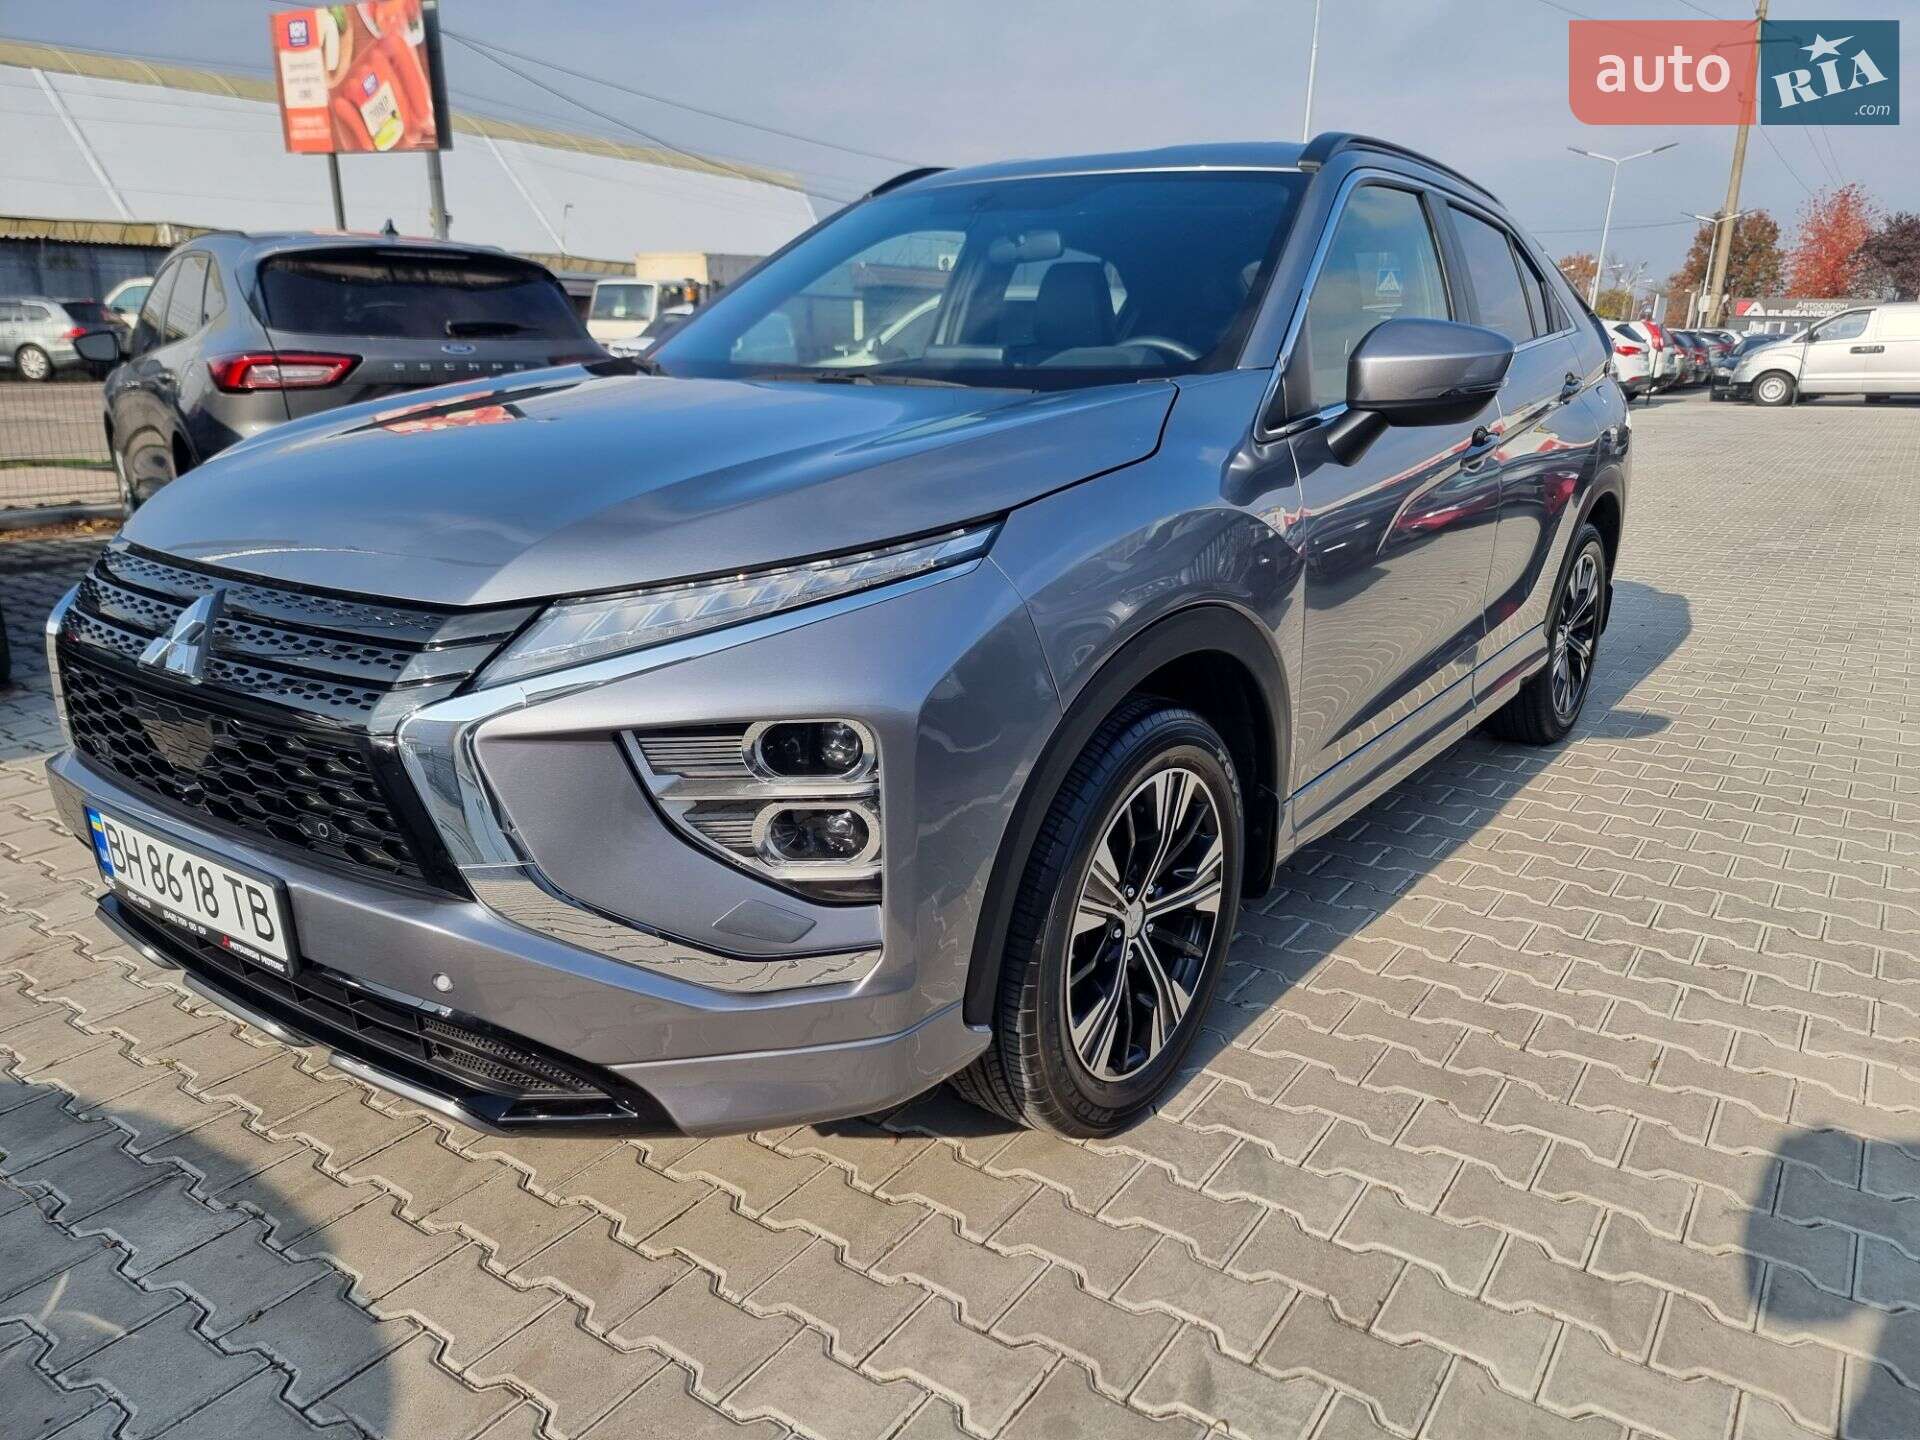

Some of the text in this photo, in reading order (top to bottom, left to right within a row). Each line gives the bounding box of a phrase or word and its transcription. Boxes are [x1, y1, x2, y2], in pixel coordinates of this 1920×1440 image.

[104, 822, 147, 887] BH
[146, 844, 220, 919] 8618
[223, 873, 275, 942] TB
